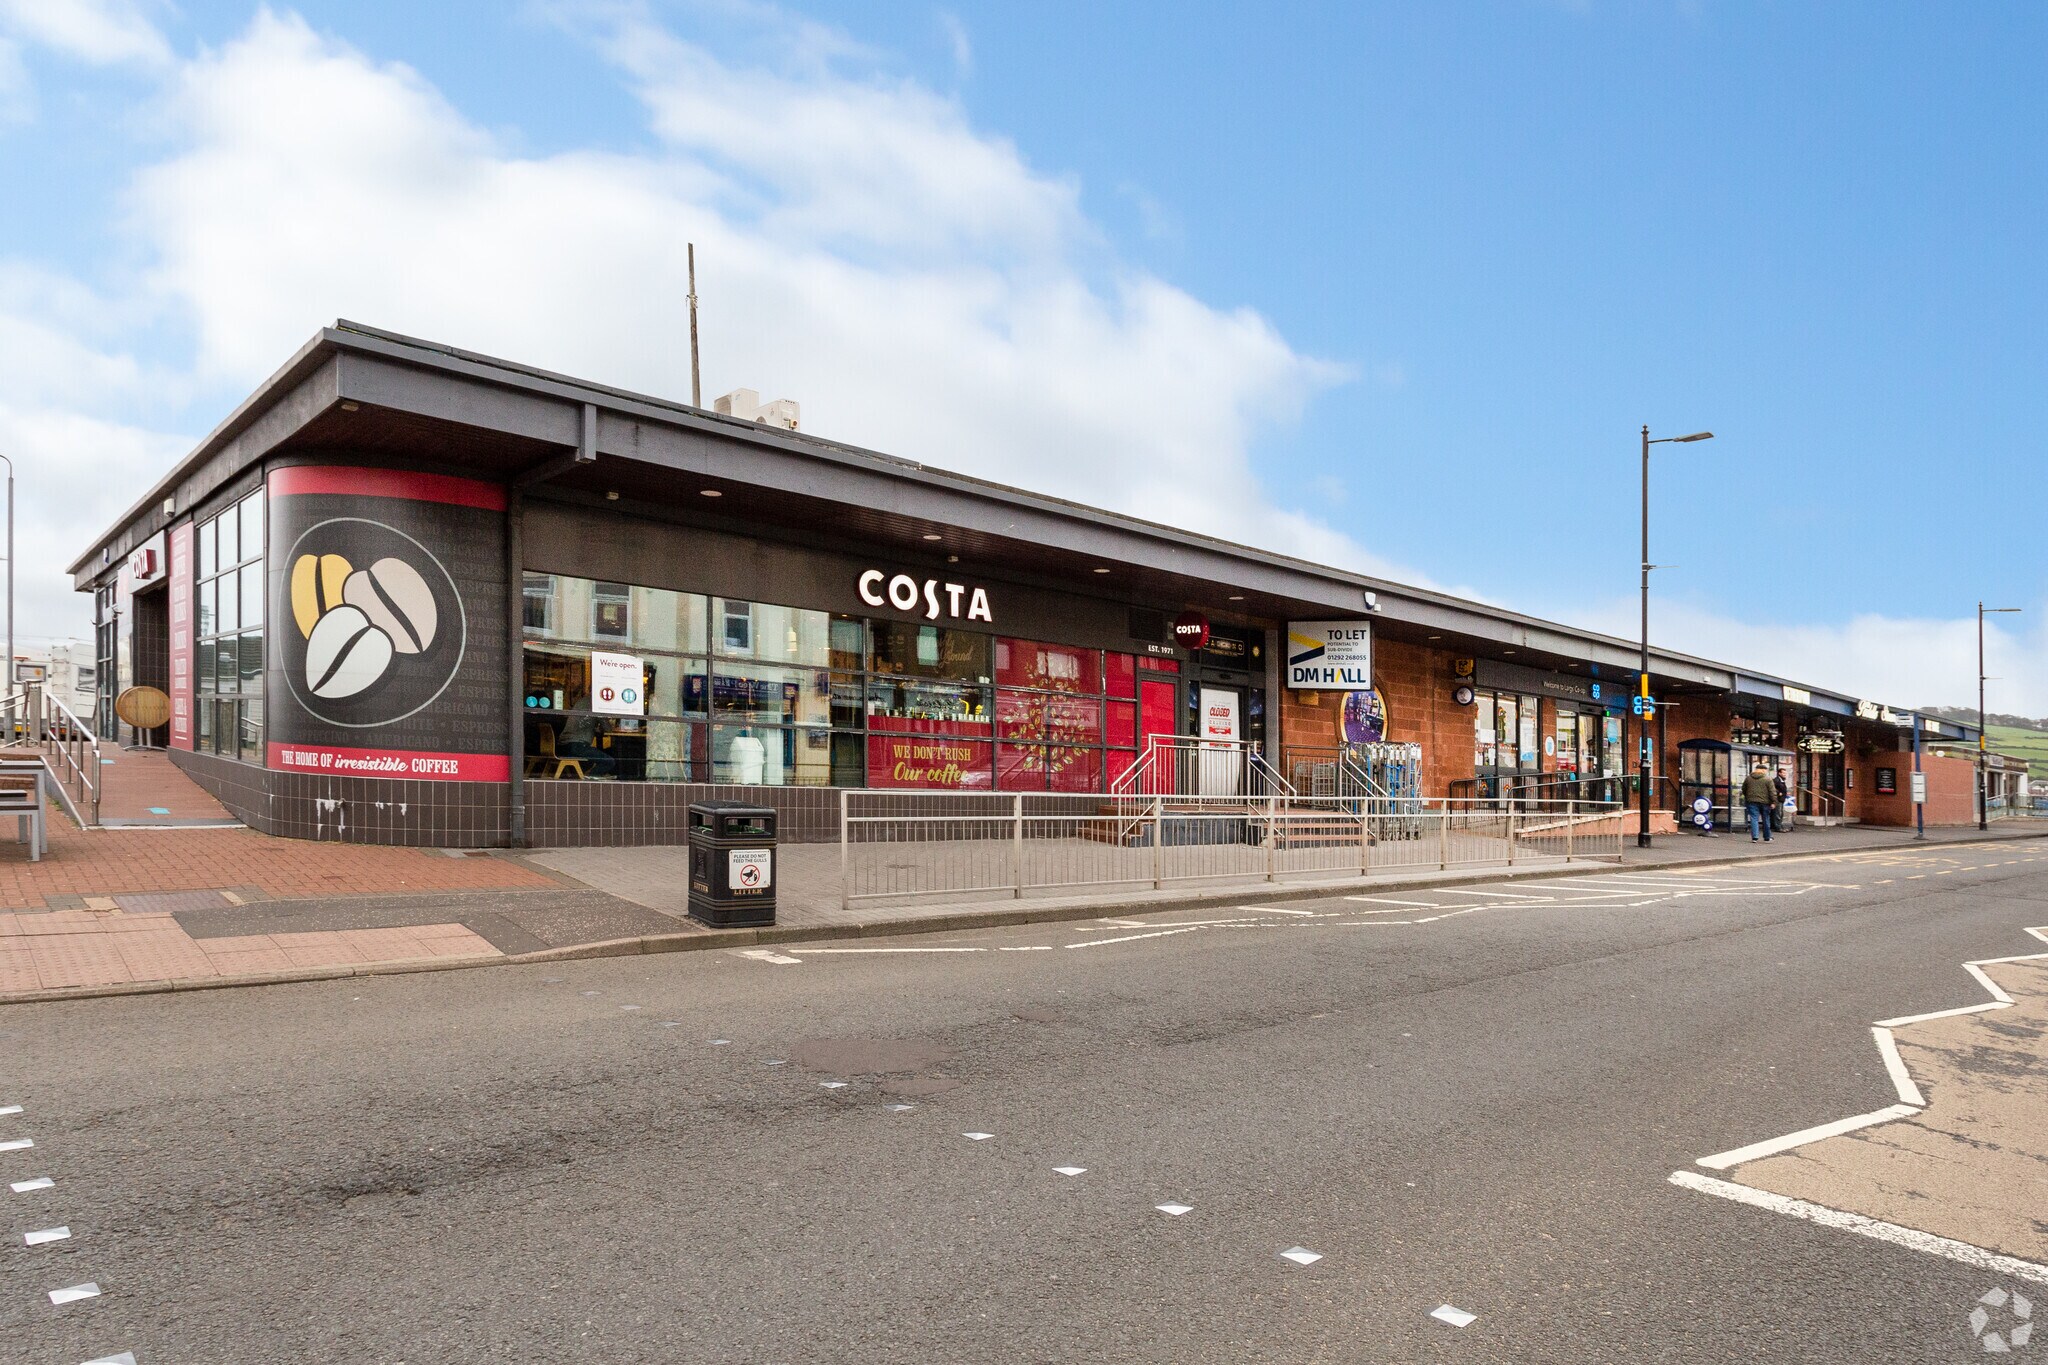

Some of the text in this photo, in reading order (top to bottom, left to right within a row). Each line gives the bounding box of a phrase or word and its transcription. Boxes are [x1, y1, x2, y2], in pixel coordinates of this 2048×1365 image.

[857, 569, 992, 622] COSTA
[1176, 625, 1201, 634] COSTA
[1327, 630, 1366, 640] TO LET
[1148, 645, 1160, 653] EST.
[600, 659, 618, 667] We're
[1293, 668, 1366, 683] DM HALL
[1210, 706, 1231, 717] CLOSED
[893, 745, 971, 760] WE DON'T RUSH
[282, 750, 458, 774] THE HOME OF irresistible COFFEE
[894, 762, 969, 785] Our coffee
